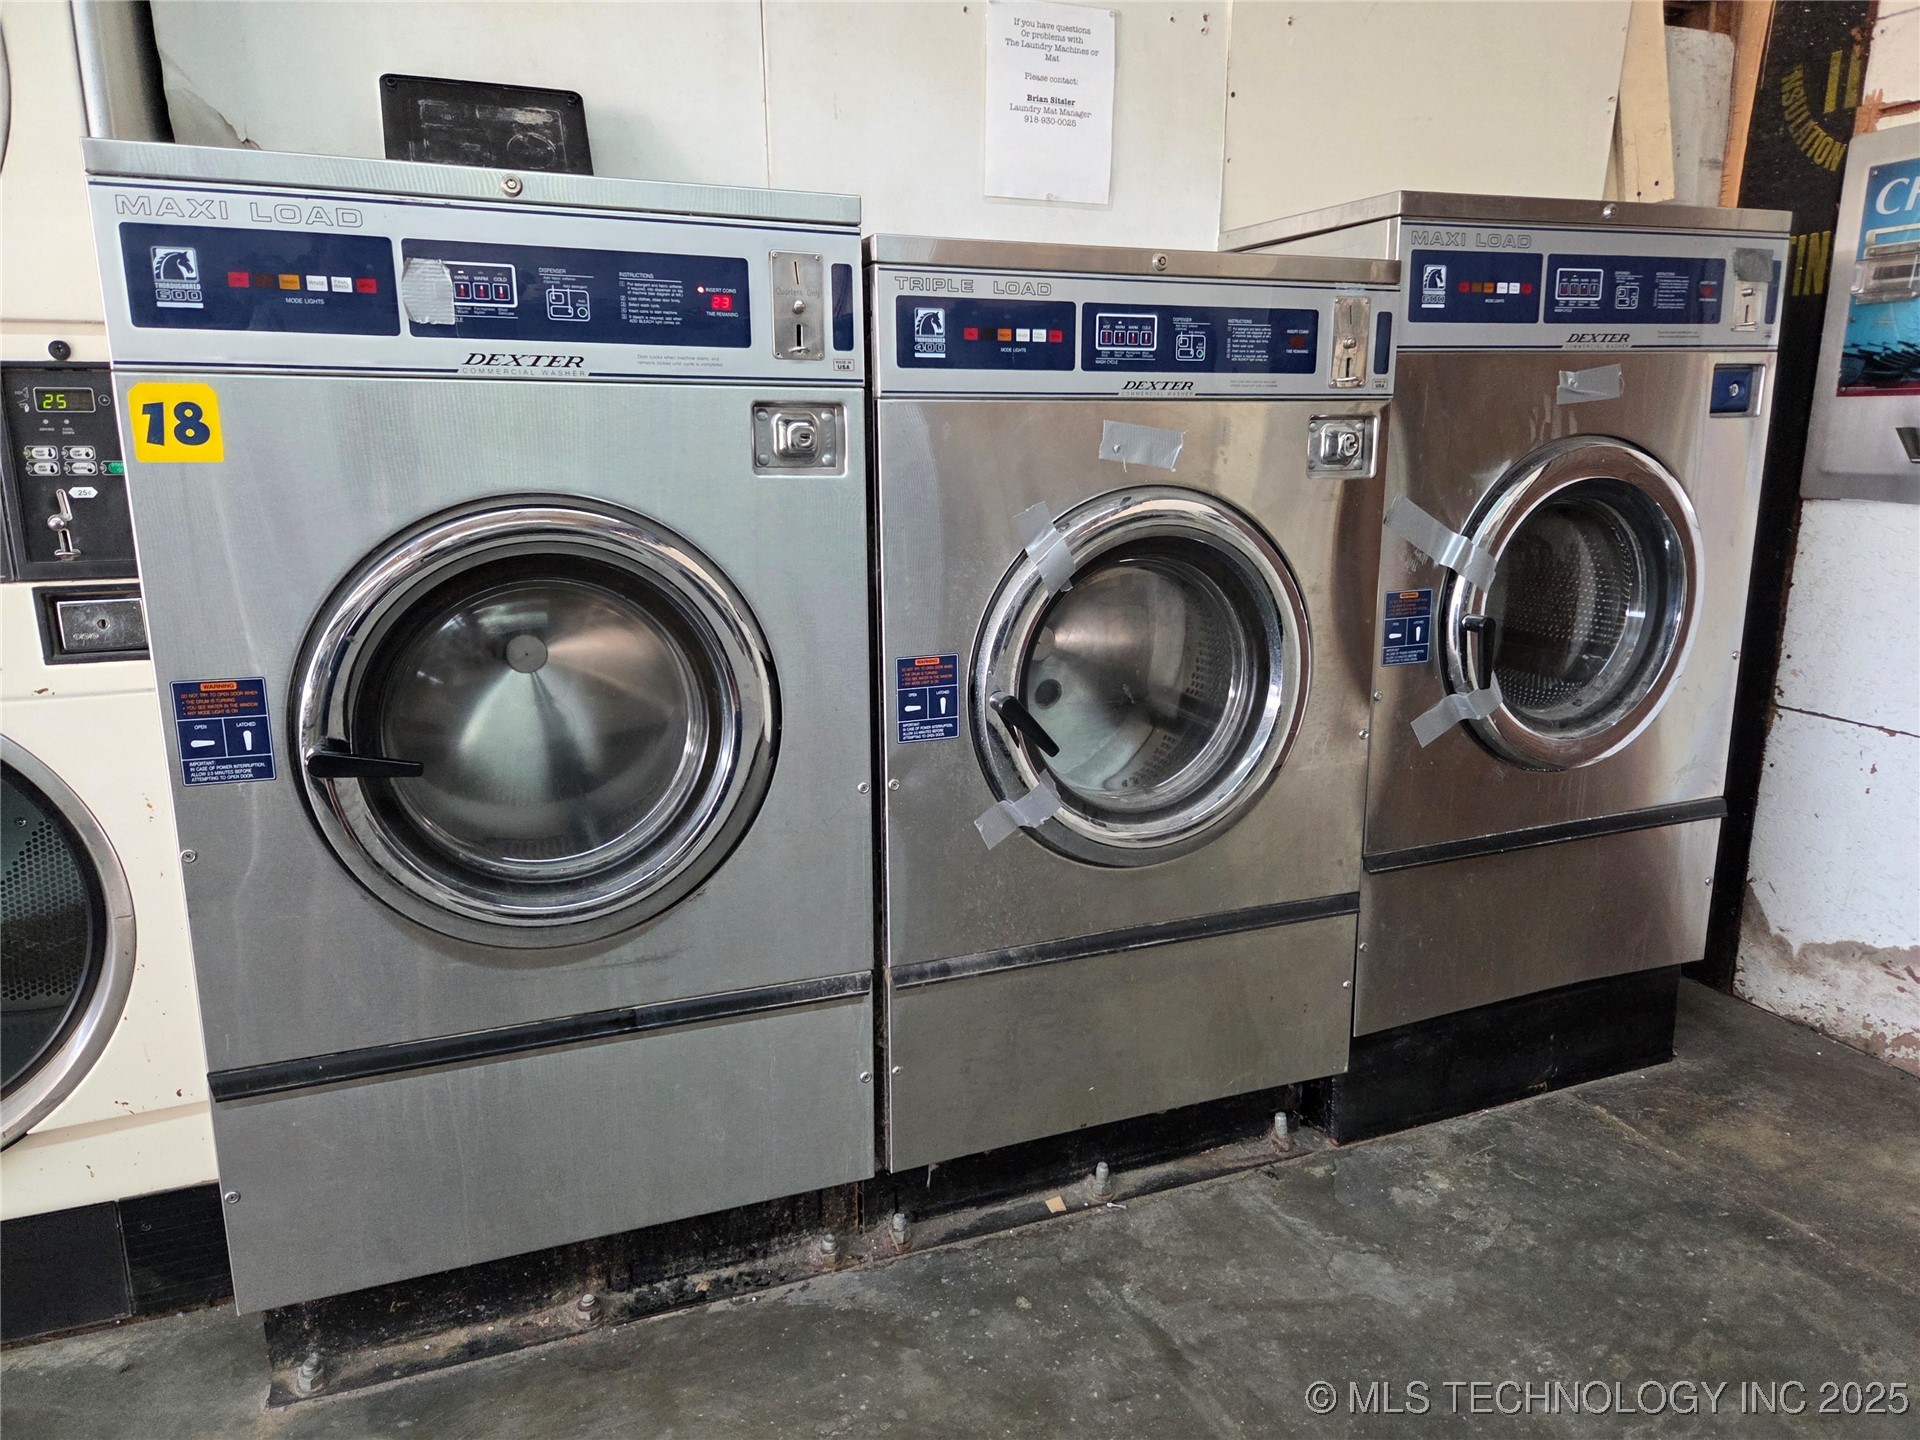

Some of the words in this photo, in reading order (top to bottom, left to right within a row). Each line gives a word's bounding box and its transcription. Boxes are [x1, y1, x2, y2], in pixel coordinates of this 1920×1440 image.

[1014, 18, 1020, 26] If
[1021, 19, 1035, 28] you
[1037, 20, 1054, 30] have
[1056, 23, 1091, 34] questions
[1032, 31, 1065, 42] problems
[1067, 35, 1083, 44] with
[1005, 38, 1020, 46] The
[1021, 40, 1052, 51] Laundry
[1055, 44, 1089, 55] Machines
[1045, 54, 1060, 62] Mat
[1025, 72, 1048, 82] Please
[1050, 75, 1078, 85] contact:
[1027, 94, 1048, 103] Brian
[1010, 103, 1041, 114] Laundry
[1044, 107, 1058, 115] Mat
[1060, 109, 1091, 119] Manager
[1024, 115, 1076, 127] 918-930-0025
[115, 194, 229, 220] MAXI
[250, 202, 364, 228] LOAD
[1411, 230, 1466, 247] MAXI
[1476, 233, 1532, 249] LOAD
[155, 282, 201, 290] THOROUGHBRED
[894, 276, 974, 293] TRIPLE
[993, 281, 1052, 296] LOAD
[156, 289, 202, 301] 600
[807, 289, 820, 299] Only
[712, 296, 730, 308] 23
[1566, 333, 1630, 343] DEXTER
[914, 343, 945, 352] 400
[461, 353, 584, 368] DEXTER
[462, 368, 535, 376] COMMERCIAL
[542, 369, 585, 377] WASHER
[1121, 380, 1194, 391] DEXTER
[43, 394, 66, 408] 25
[142, 402, 210, 446] 18
